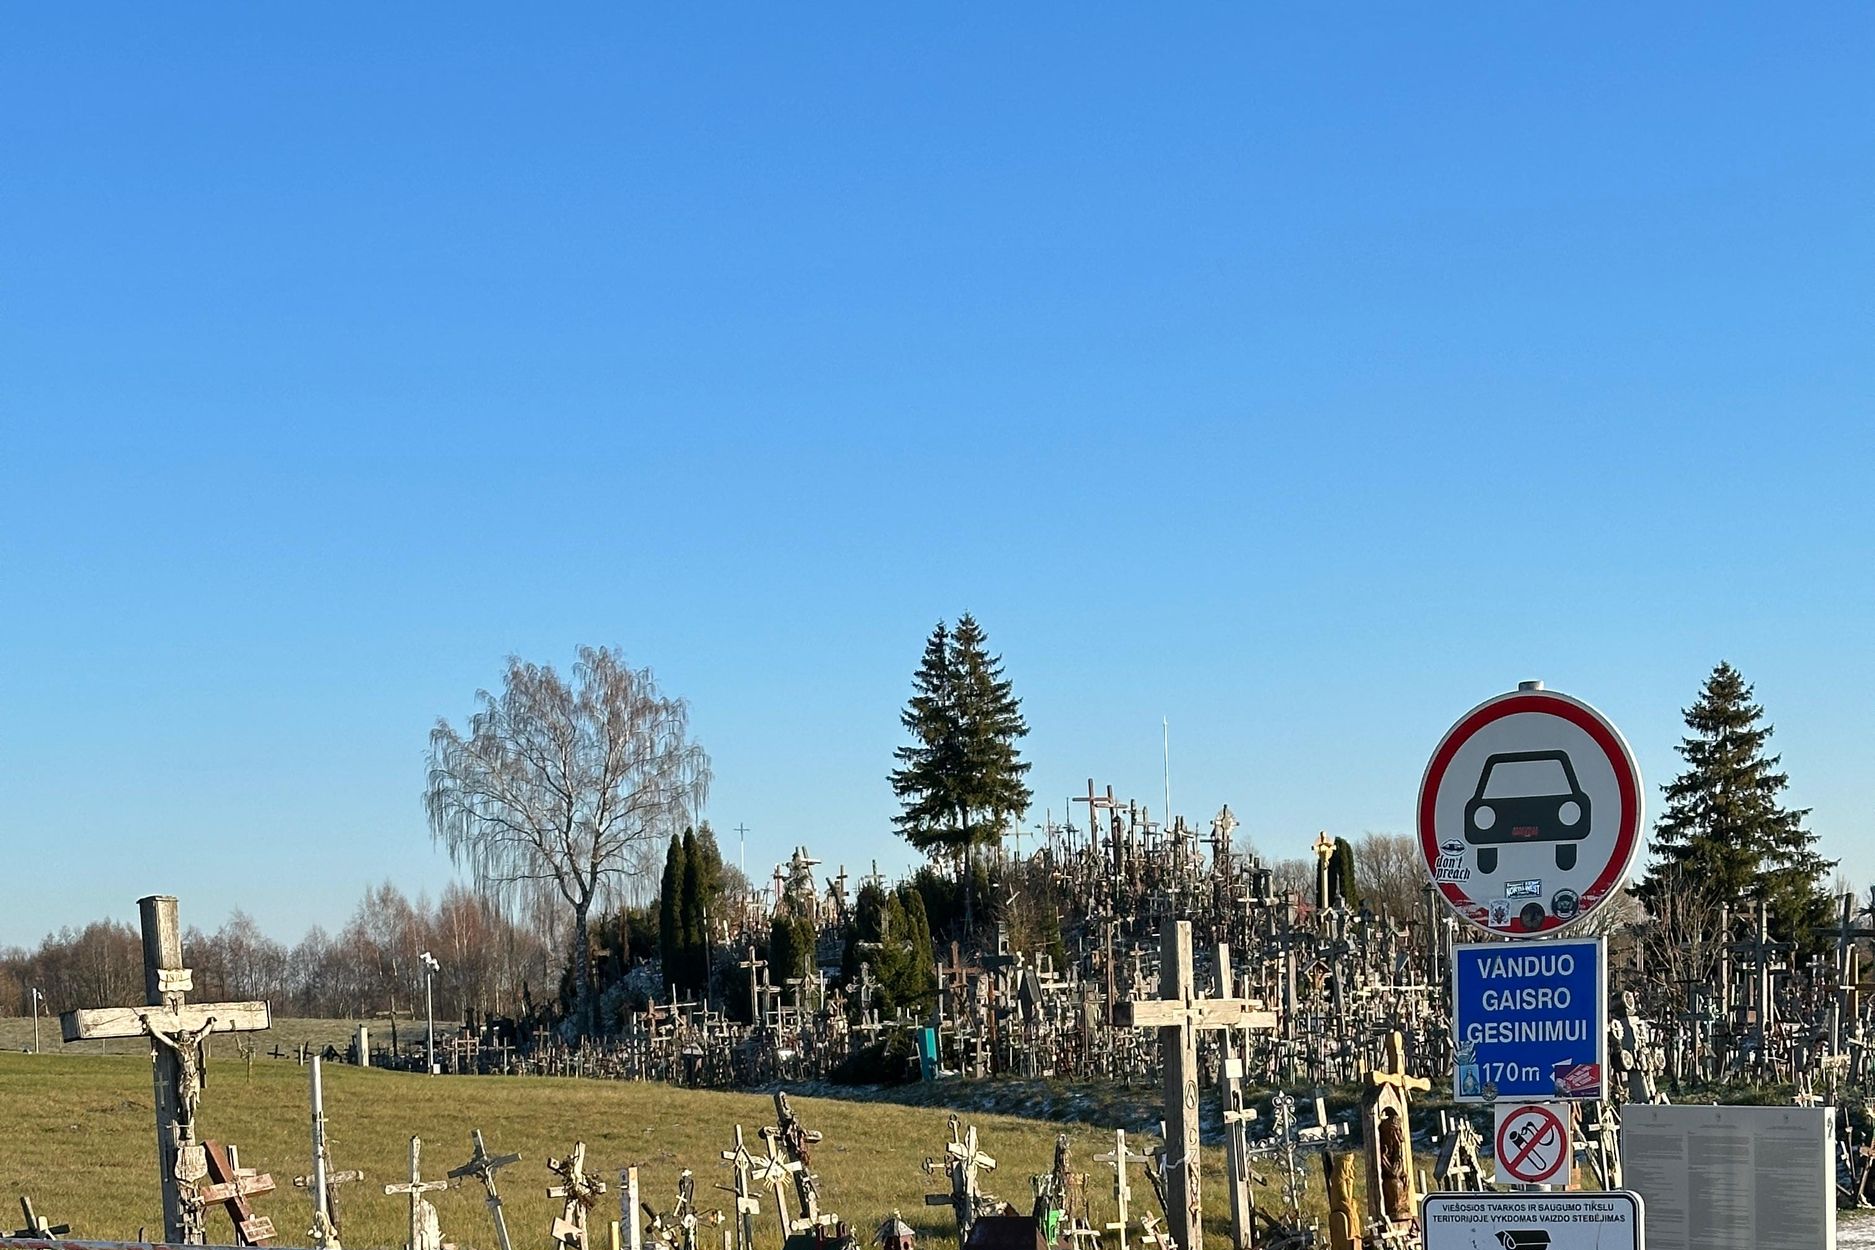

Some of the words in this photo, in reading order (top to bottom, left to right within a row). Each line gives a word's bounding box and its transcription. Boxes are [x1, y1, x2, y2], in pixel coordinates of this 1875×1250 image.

[1436, 855, 1463, 868] don't
[1435, 867, 1471, 880] preach
[1477, 954, 1575, 979] VANDUO
[1482, 987, 1571, 1011] GAISRO
[1466, 1019, 1587, 1044] GESINIMUI
[1442, 1203, 1485, 1212] VIEŠOSIOS
[1487, 1204, 1526, 1212] TVARKOS
[1528, 1204, 1537, 1212] IR
[1538, 1204, 1582, 1212] SAUGUMO
[1584, 1203, 1614, 1212] TIKSLU
[1432, 1214, 1488, 1223] TERITORIJOJE
[1490, 1215, 1537, 1223] VYKDOMAS
[1539, 1215, 1570, 1223] VAIZDO
[1572, 1213, 1625, 1223] STEBĖJIMAS
